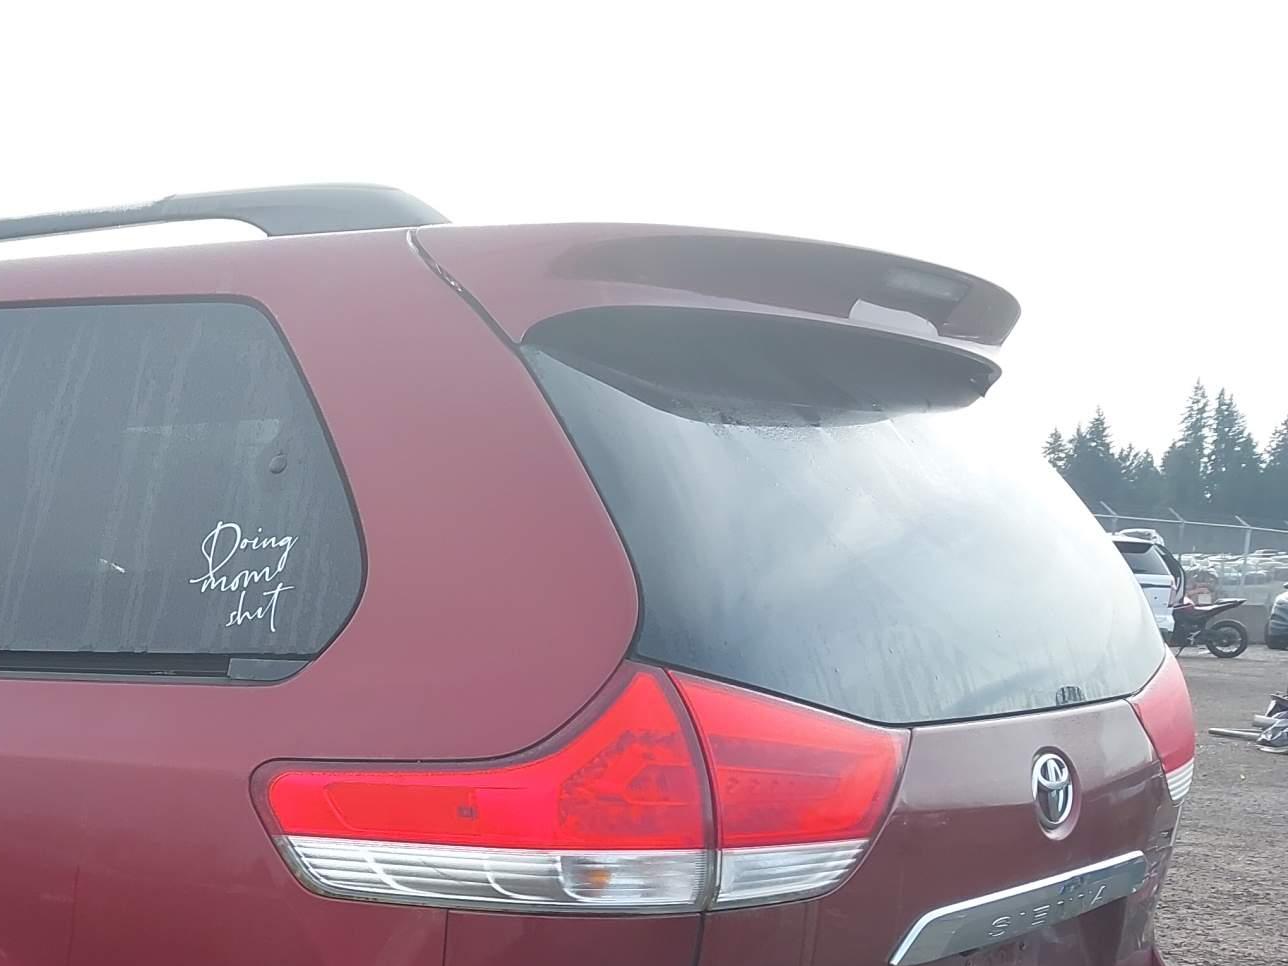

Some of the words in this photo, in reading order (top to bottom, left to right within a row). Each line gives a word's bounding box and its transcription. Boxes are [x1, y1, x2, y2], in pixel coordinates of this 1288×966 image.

[191, 521, 299, 577] Doing
[195, 565, 277, 593] mom
[225, 582, 295, 632] shit
